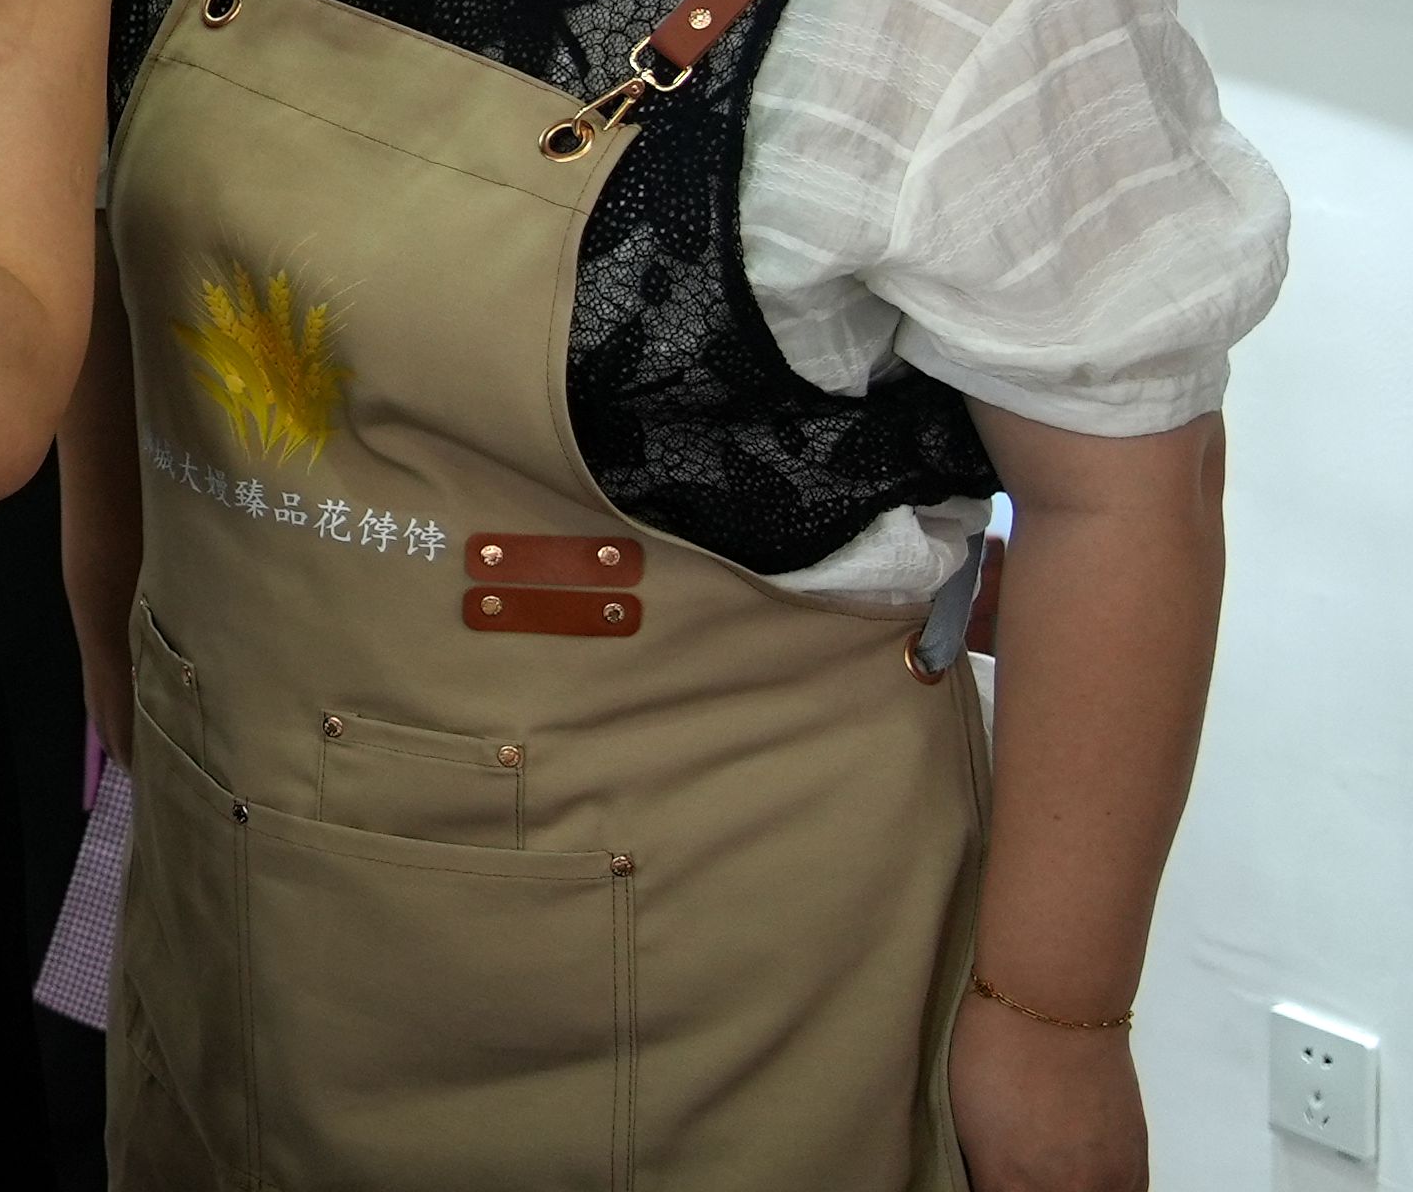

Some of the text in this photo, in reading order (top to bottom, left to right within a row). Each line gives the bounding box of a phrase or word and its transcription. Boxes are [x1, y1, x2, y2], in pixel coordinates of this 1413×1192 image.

[142, 435, 446, 562] 城大嫚臻品花饽饽
